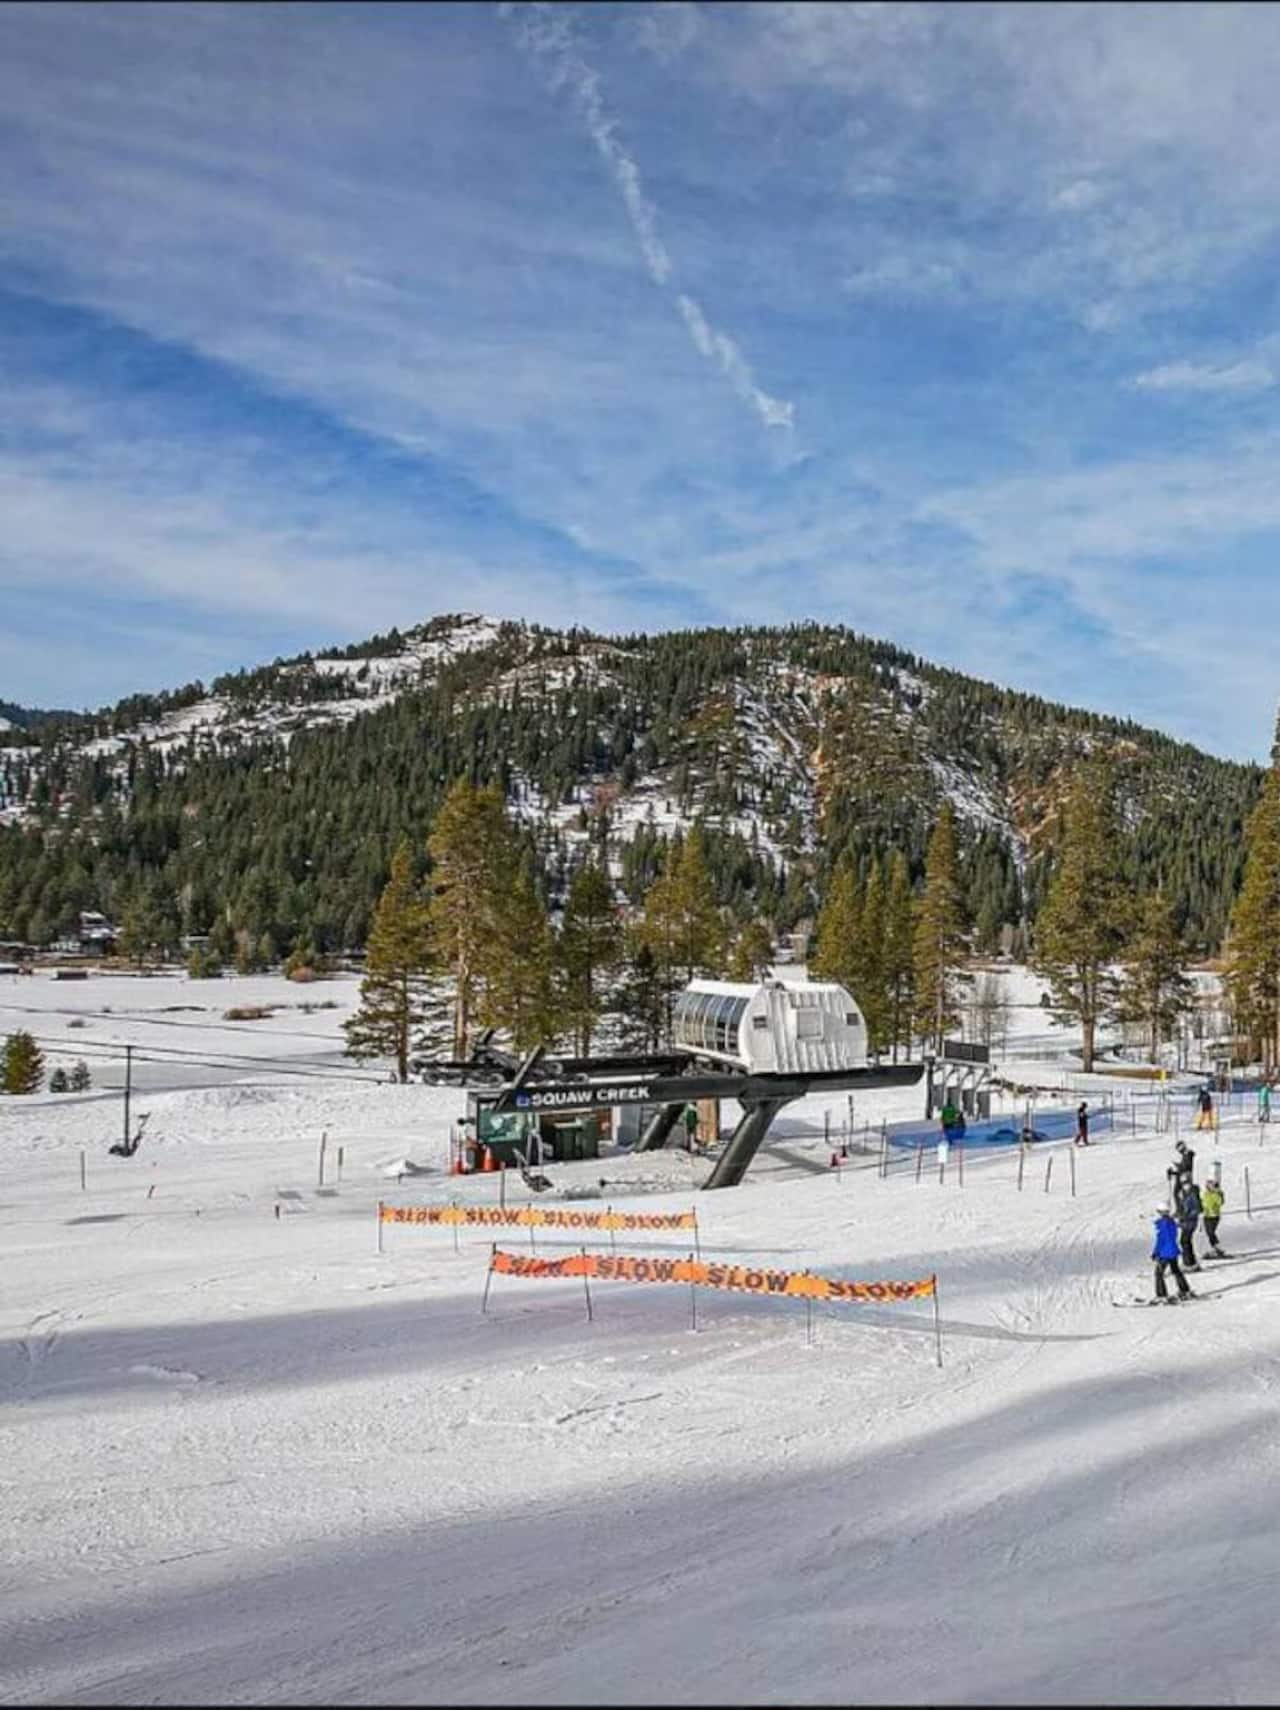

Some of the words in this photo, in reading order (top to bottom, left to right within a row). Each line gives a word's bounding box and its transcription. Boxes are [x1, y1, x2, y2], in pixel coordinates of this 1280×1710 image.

[532, 1090, 593, 1107] SQUAW
[597, 1086, 650, 1101] CREEK
[465, 1208, 520, 1224] SLOW
[544, 1210, 600, 1227] SLOW
[624, 1213, 684, 1229] SLOW
[597, 1258, 676, 1281] SLOW
[707, 1267, 789, 1292] SLOW
[828, 1280, 914, 1298] SLOW
